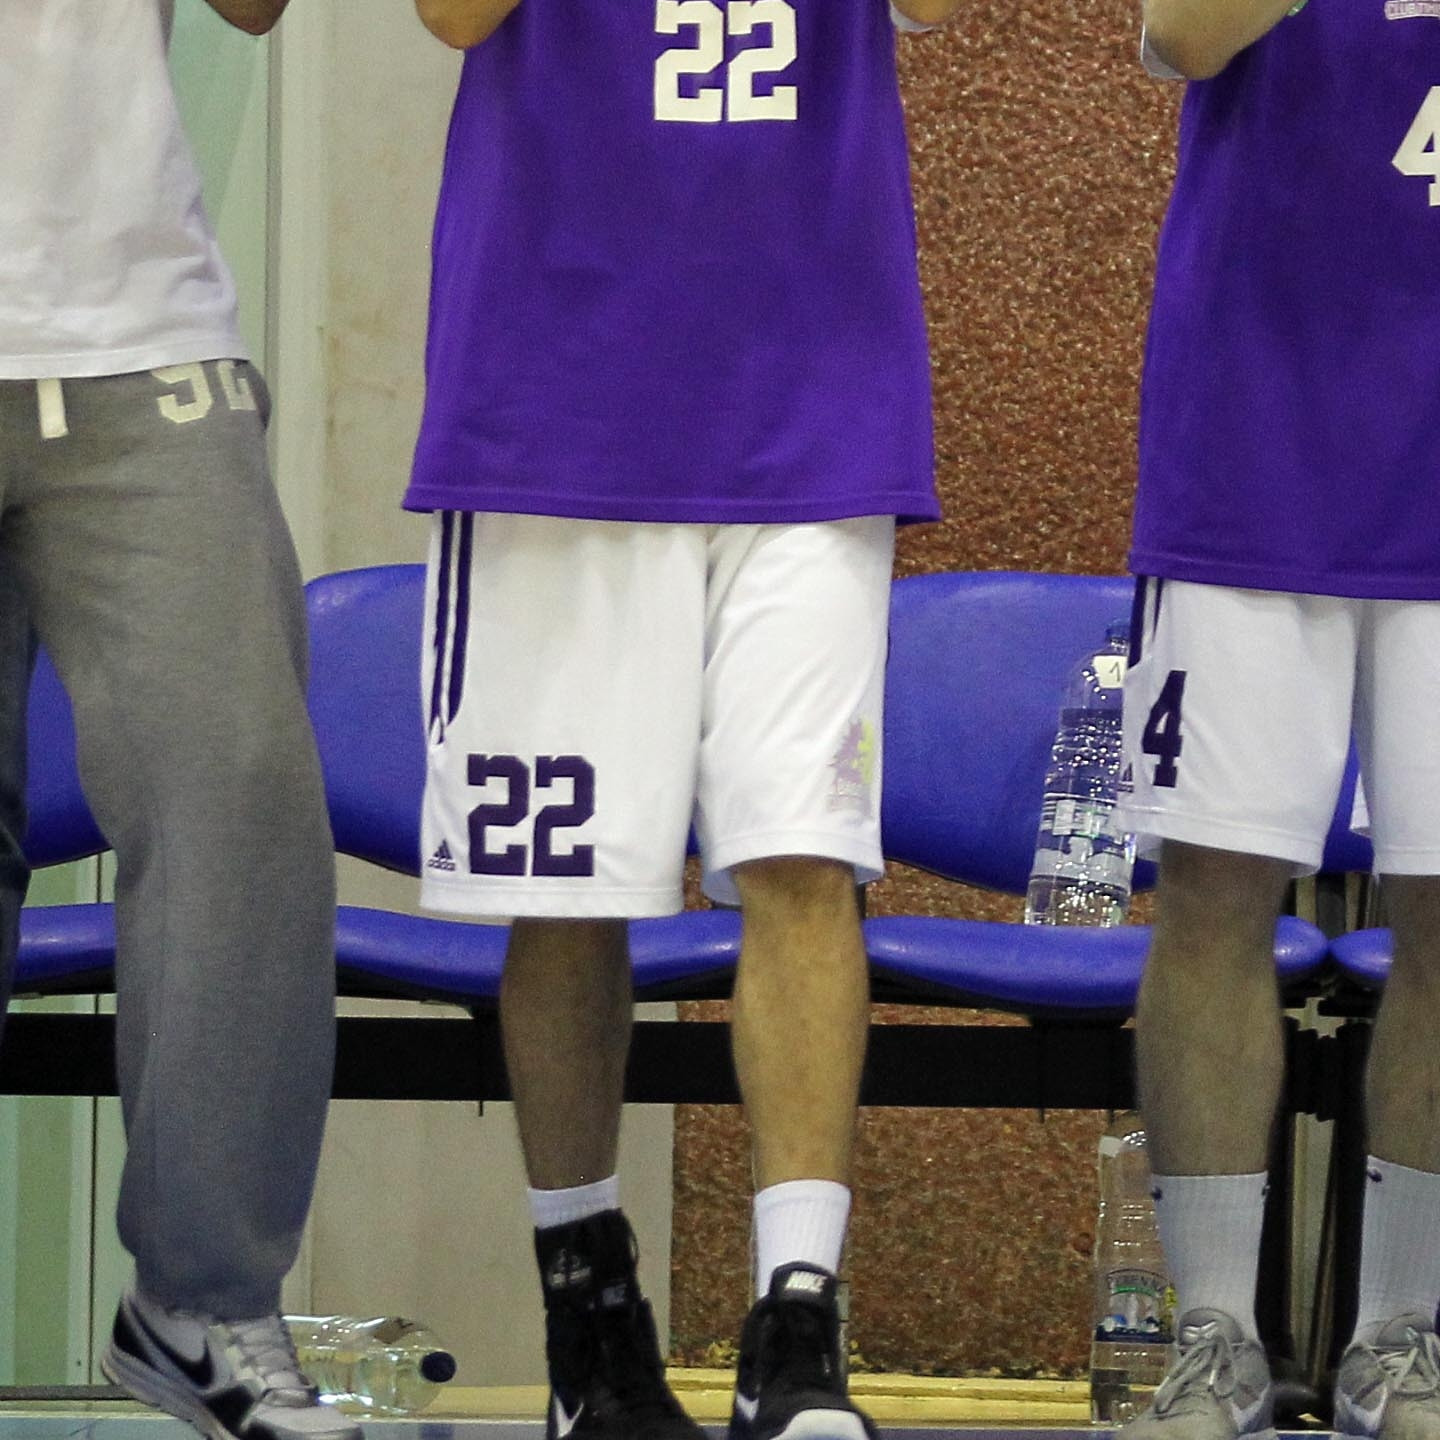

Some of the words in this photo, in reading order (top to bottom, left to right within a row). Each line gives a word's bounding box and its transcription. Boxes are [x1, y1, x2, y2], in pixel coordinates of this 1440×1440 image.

[654, 0, 798, 122] 22
[1141, 670, 1188, 788] 4
[467, 753, 596, 877] 22
